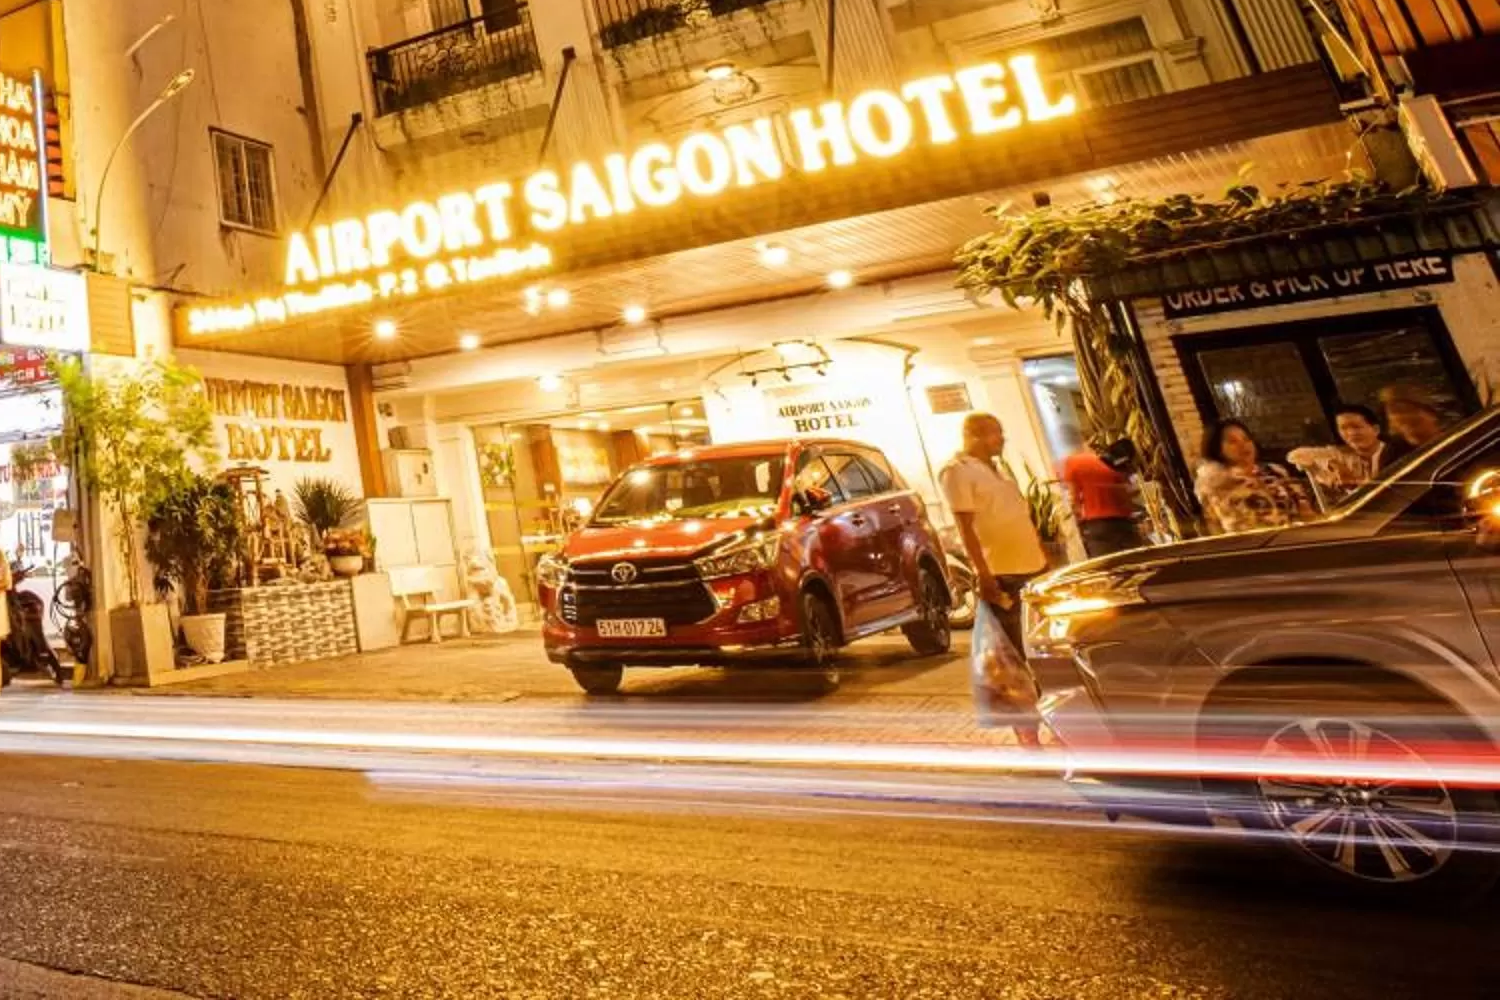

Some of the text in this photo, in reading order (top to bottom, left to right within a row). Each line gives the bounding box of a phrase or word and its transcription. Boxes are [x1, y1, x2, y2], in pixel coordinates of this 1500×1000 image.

[285, 53, 1077, 284] AIRPORT SAIGON HOTEL
[778, 401, 826, 418] AIRPORT
[794, 413, 859, 433] HOTEL
[225, 423, 332, 463] HOTEL
